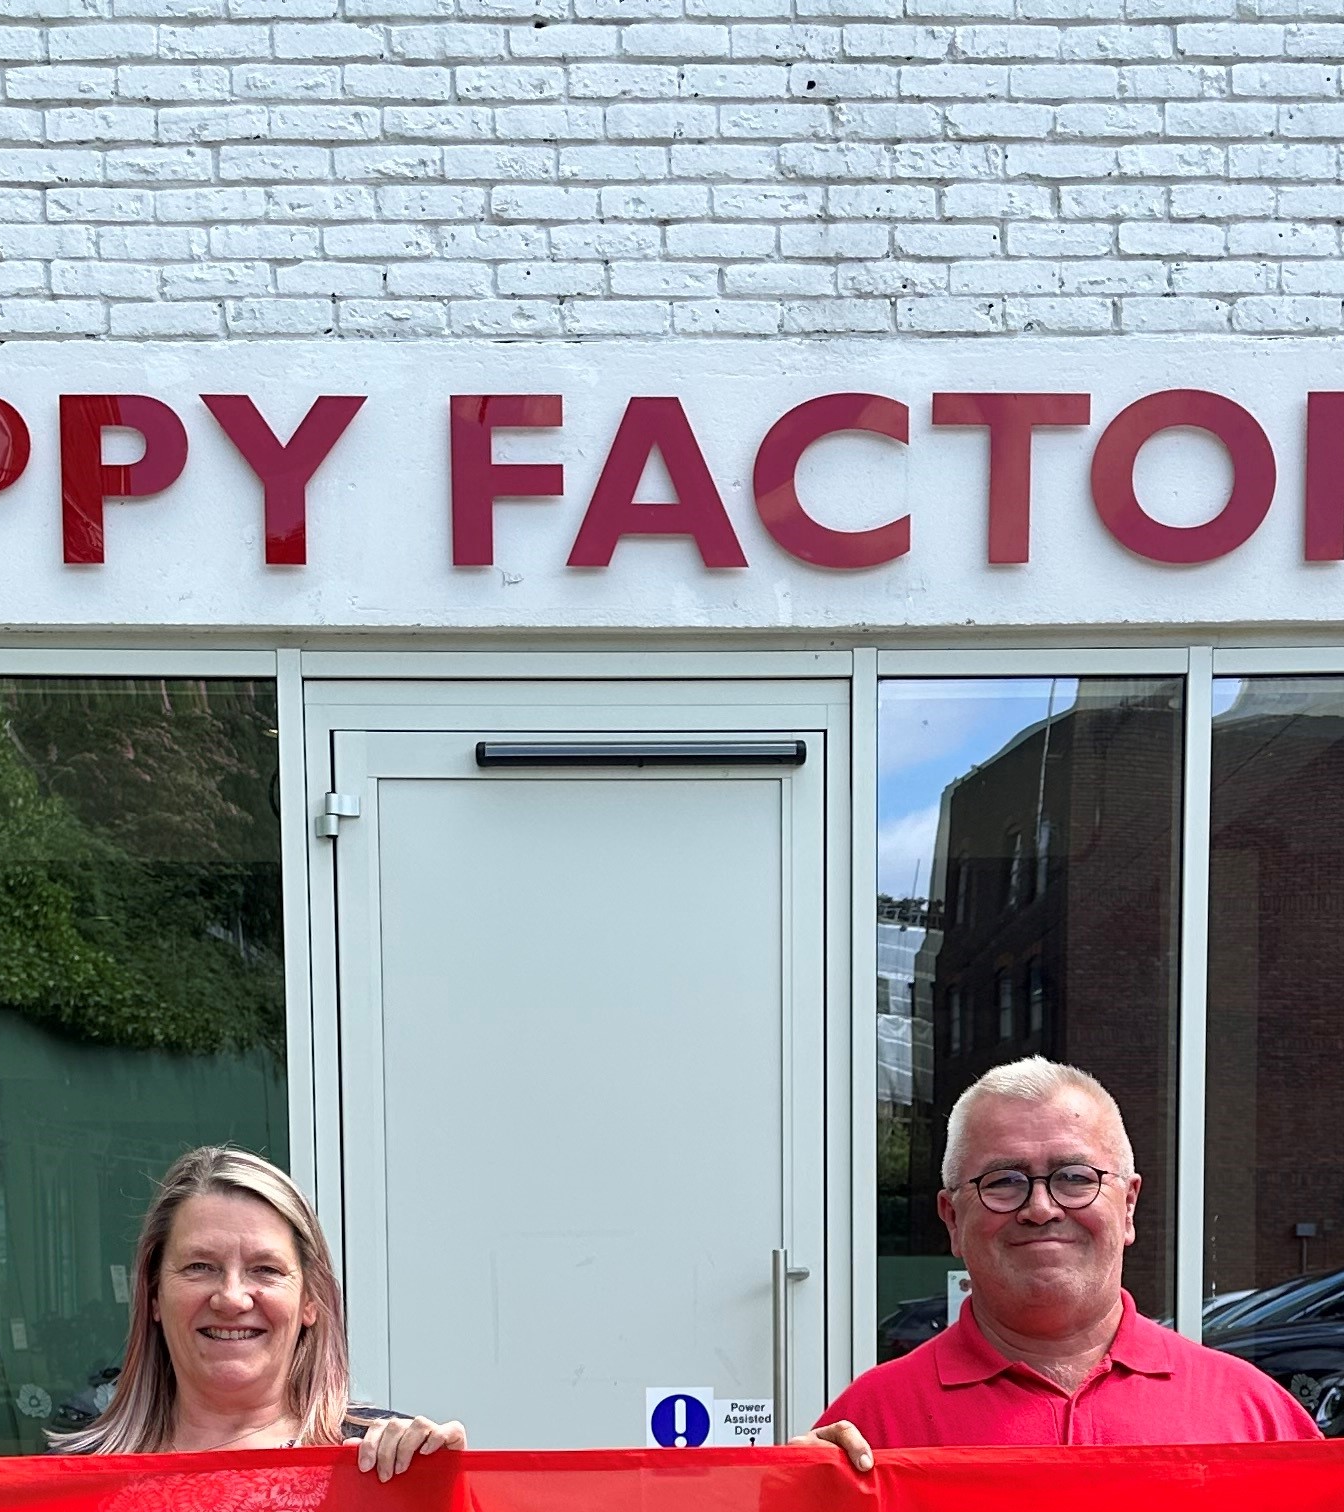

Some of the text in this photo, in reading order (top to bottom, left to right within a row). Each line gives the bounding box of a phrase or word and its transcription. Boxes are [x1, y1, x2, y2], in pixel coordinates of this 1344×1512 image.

[731, 1403, 765, 1412] Power
[724, 1414, 771, 1424] Assisted
[734, 1426, 762, 1435] Door
